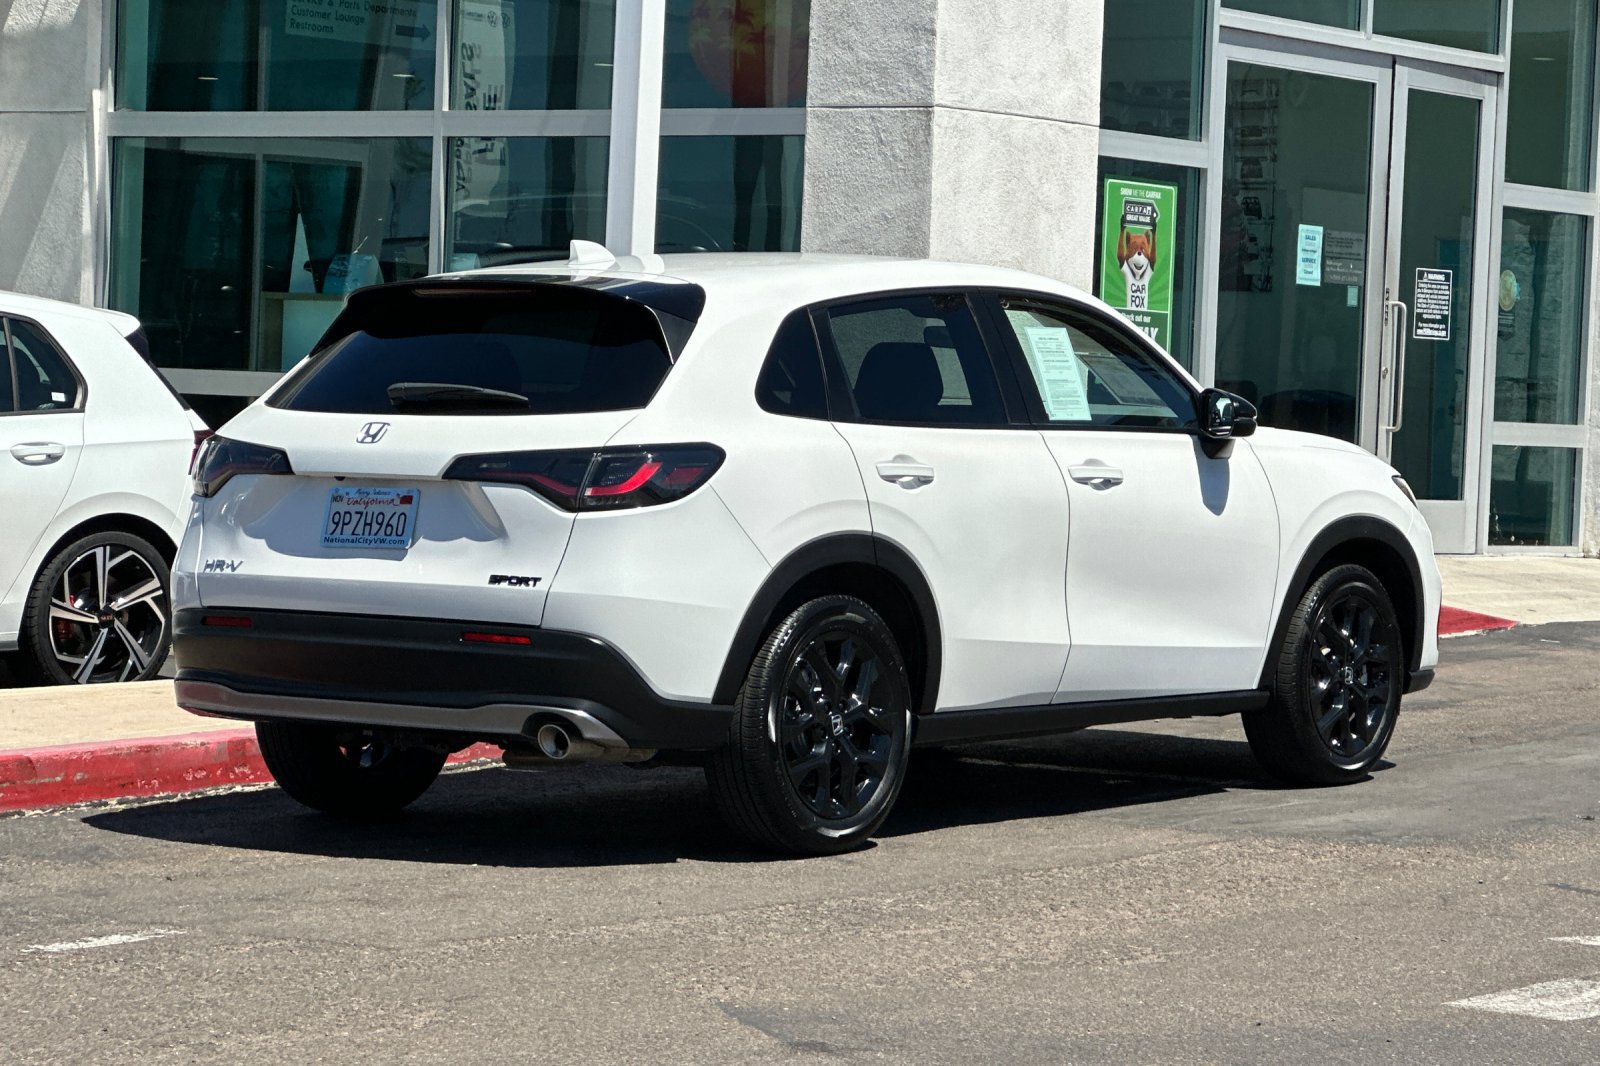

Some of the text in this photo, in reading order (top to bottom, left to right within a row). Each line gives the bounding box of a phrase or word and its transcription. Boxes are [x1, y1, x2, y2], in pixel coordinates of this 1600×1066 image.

[291, 4, 366, 26] Customer Lounge
[290, 18, 334, 32] Restrooms
[1130, 283, 1146, 295] CAR
[1130, 295, 1145, 308] FOX
[346, 497, 399, 510] California
[329, 510, 408, 537] 9PZH960
[323, 536, 405, 546] NationalCityVW.com
[488, 574, 543, 588] SPORT
